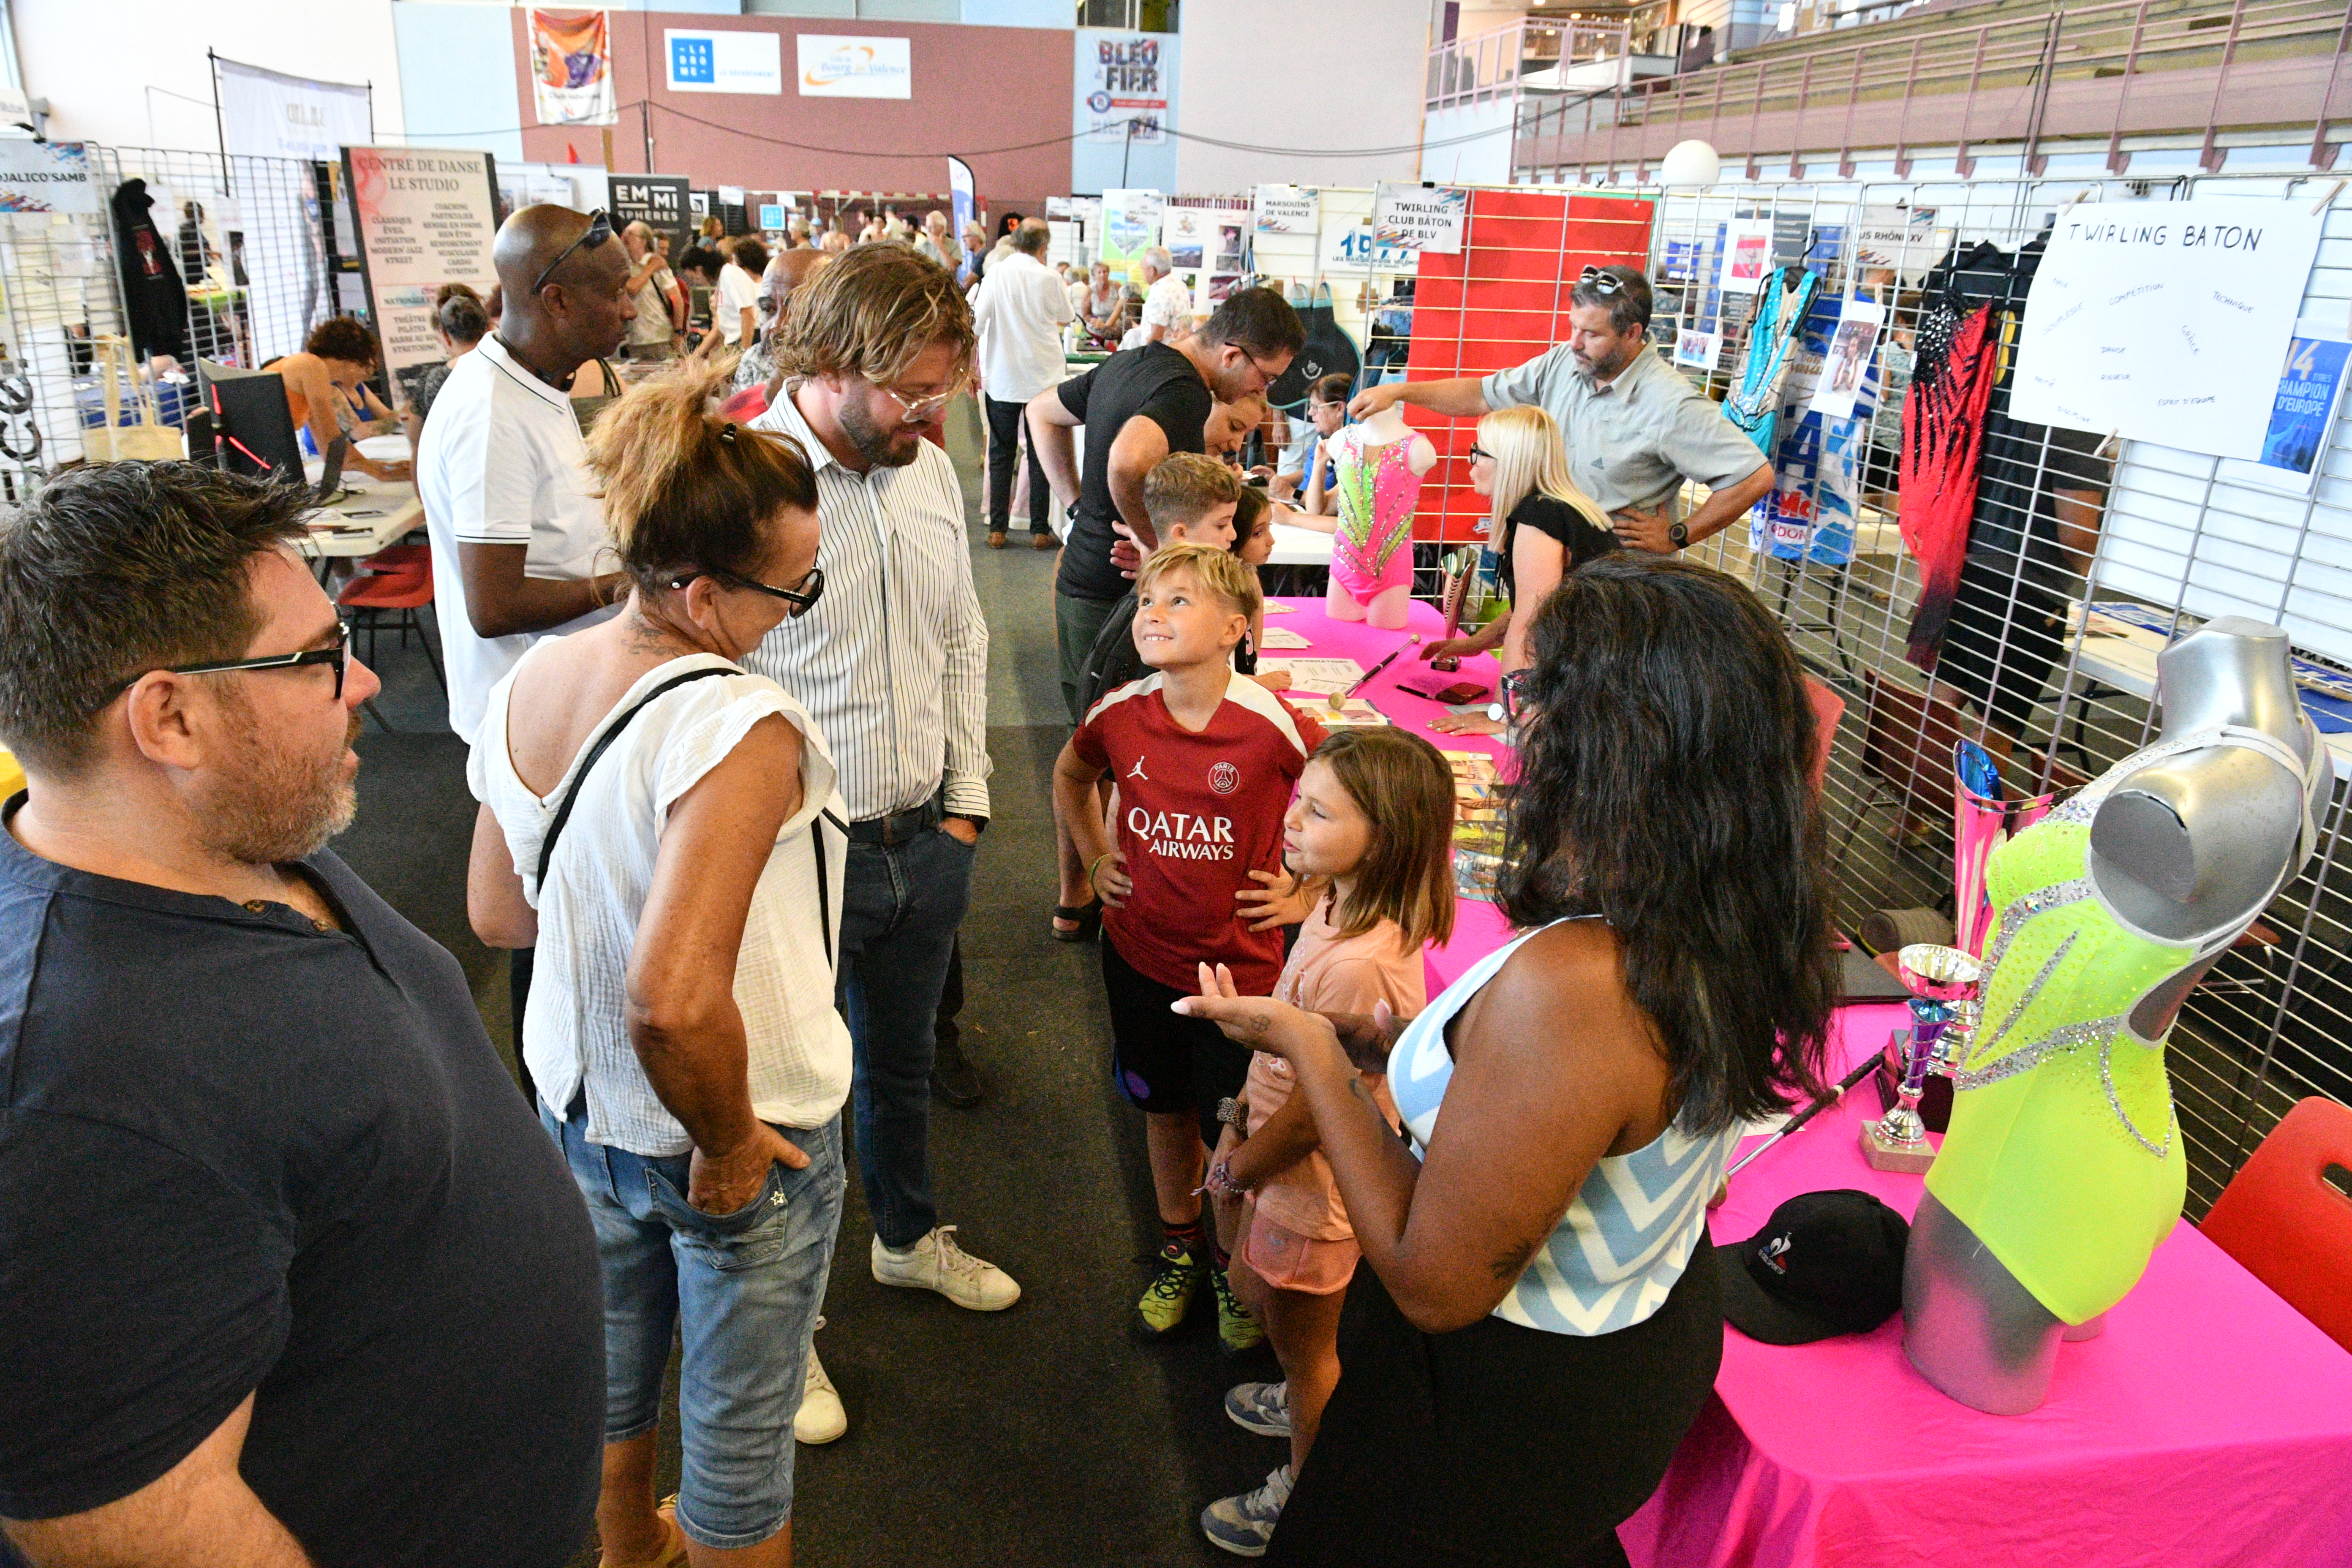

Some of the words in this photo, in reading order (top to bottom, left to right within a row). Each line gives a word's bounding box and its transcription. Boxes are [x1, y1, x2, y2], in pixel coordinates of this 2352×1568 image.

[358, 157, 414, 170] CENTRE
[417, 161, 435, 171] DE
[438, 161, 482, 174] DANSE
[389, 177, 406, 190] LE
[409, 179, 459, 191] STUDIO
[615, 185, 649, 201] EM
[653, 193, 678, 209] MI
[1266, 200, 1310, 208] MARSOUINS
[1395, 202, 1449, 214] TWIRLING
[1278, 210, 1309, 218] VALENCE
[1388, 215, 1415, 225] CLUB
[1418, 214, 1452, 227] BÂTON
[1402, 229, 1415, 237] DE
[1418, 230, 1437, 239] BLV
[1910, 234, 1923, 242] XV
[2069, 218, 2167, 245] TWIRLING
[2183, 225, 2263, 251] BATON
[2109, 282, 2164, 306] COMPÉTITION
[2212, 291, 2254, 314] TECHNIQUE
[2281, 339, 2321, 380] 14
[2276, 396, 2325, 417] D'EUROPE
[1214, 764, 1234, 773] PARIS
[1128, 807, 1234, 842] QATAR
[1149, 838, 1233, 860] AIRWAYS
